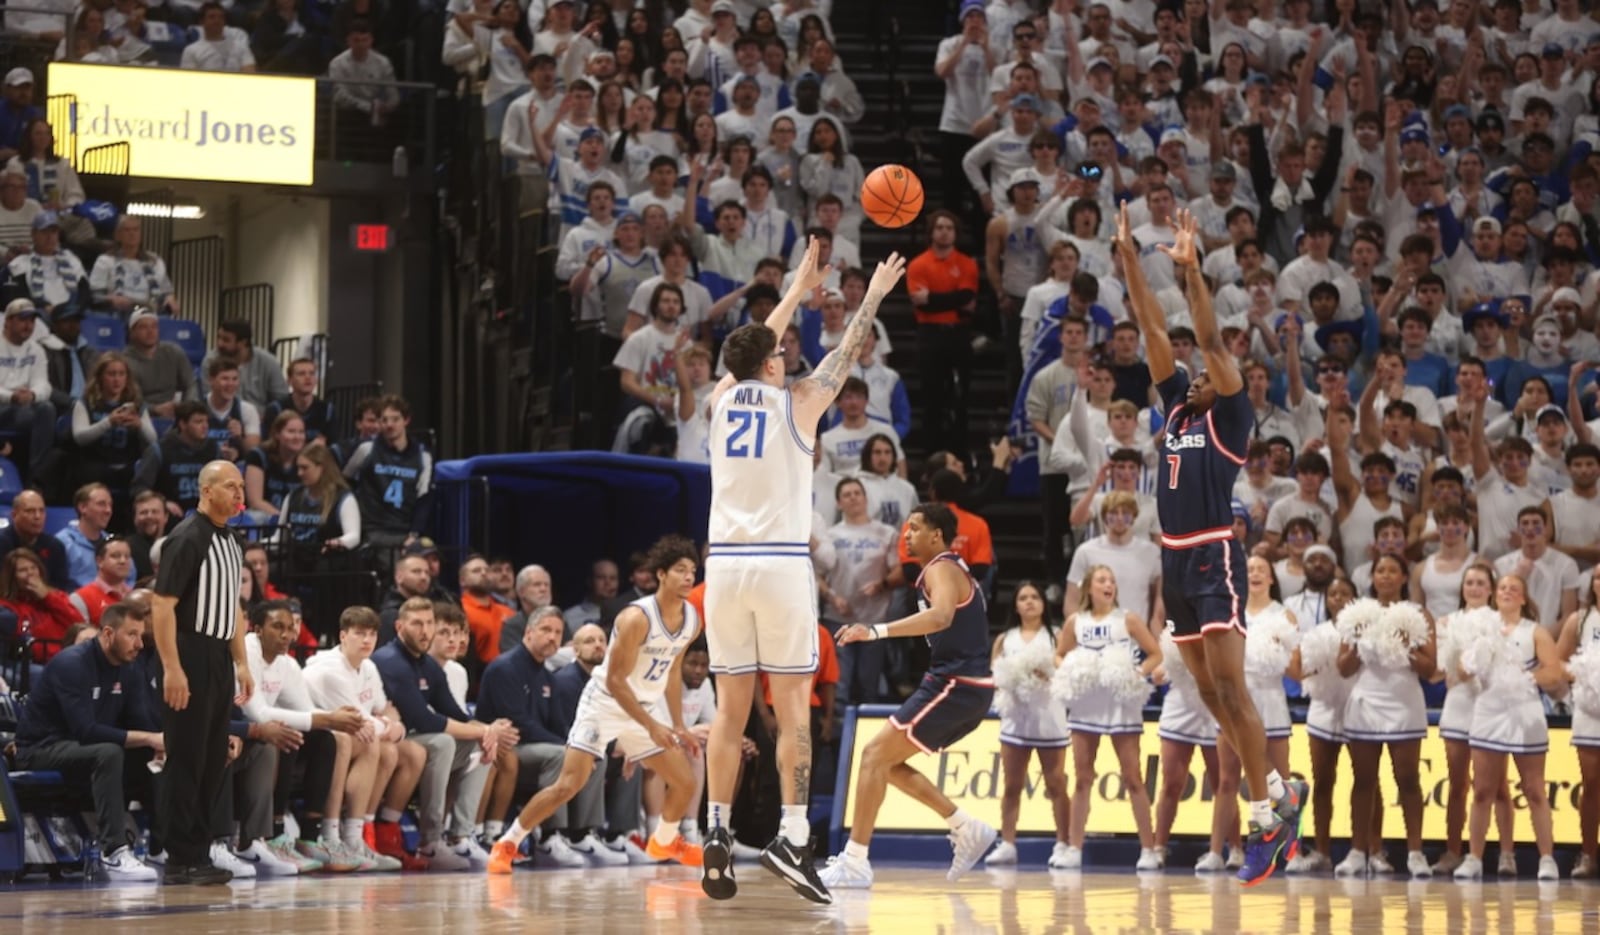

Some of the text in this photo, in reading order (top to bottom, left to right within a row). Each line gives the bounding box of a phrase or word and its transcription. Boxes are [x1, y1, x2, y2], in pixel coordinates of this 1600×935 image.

[69, 101, 297, 147] Edward Jones
[734, 387, 763, 406] AVILA
[726, 410, 767, 458] 21
[1166, 454, 1181, 490] 7
[1396, 471, 1417, 494] 45
[383, 479, 404, 508] 4
[643, 658, 671, 681] 13
